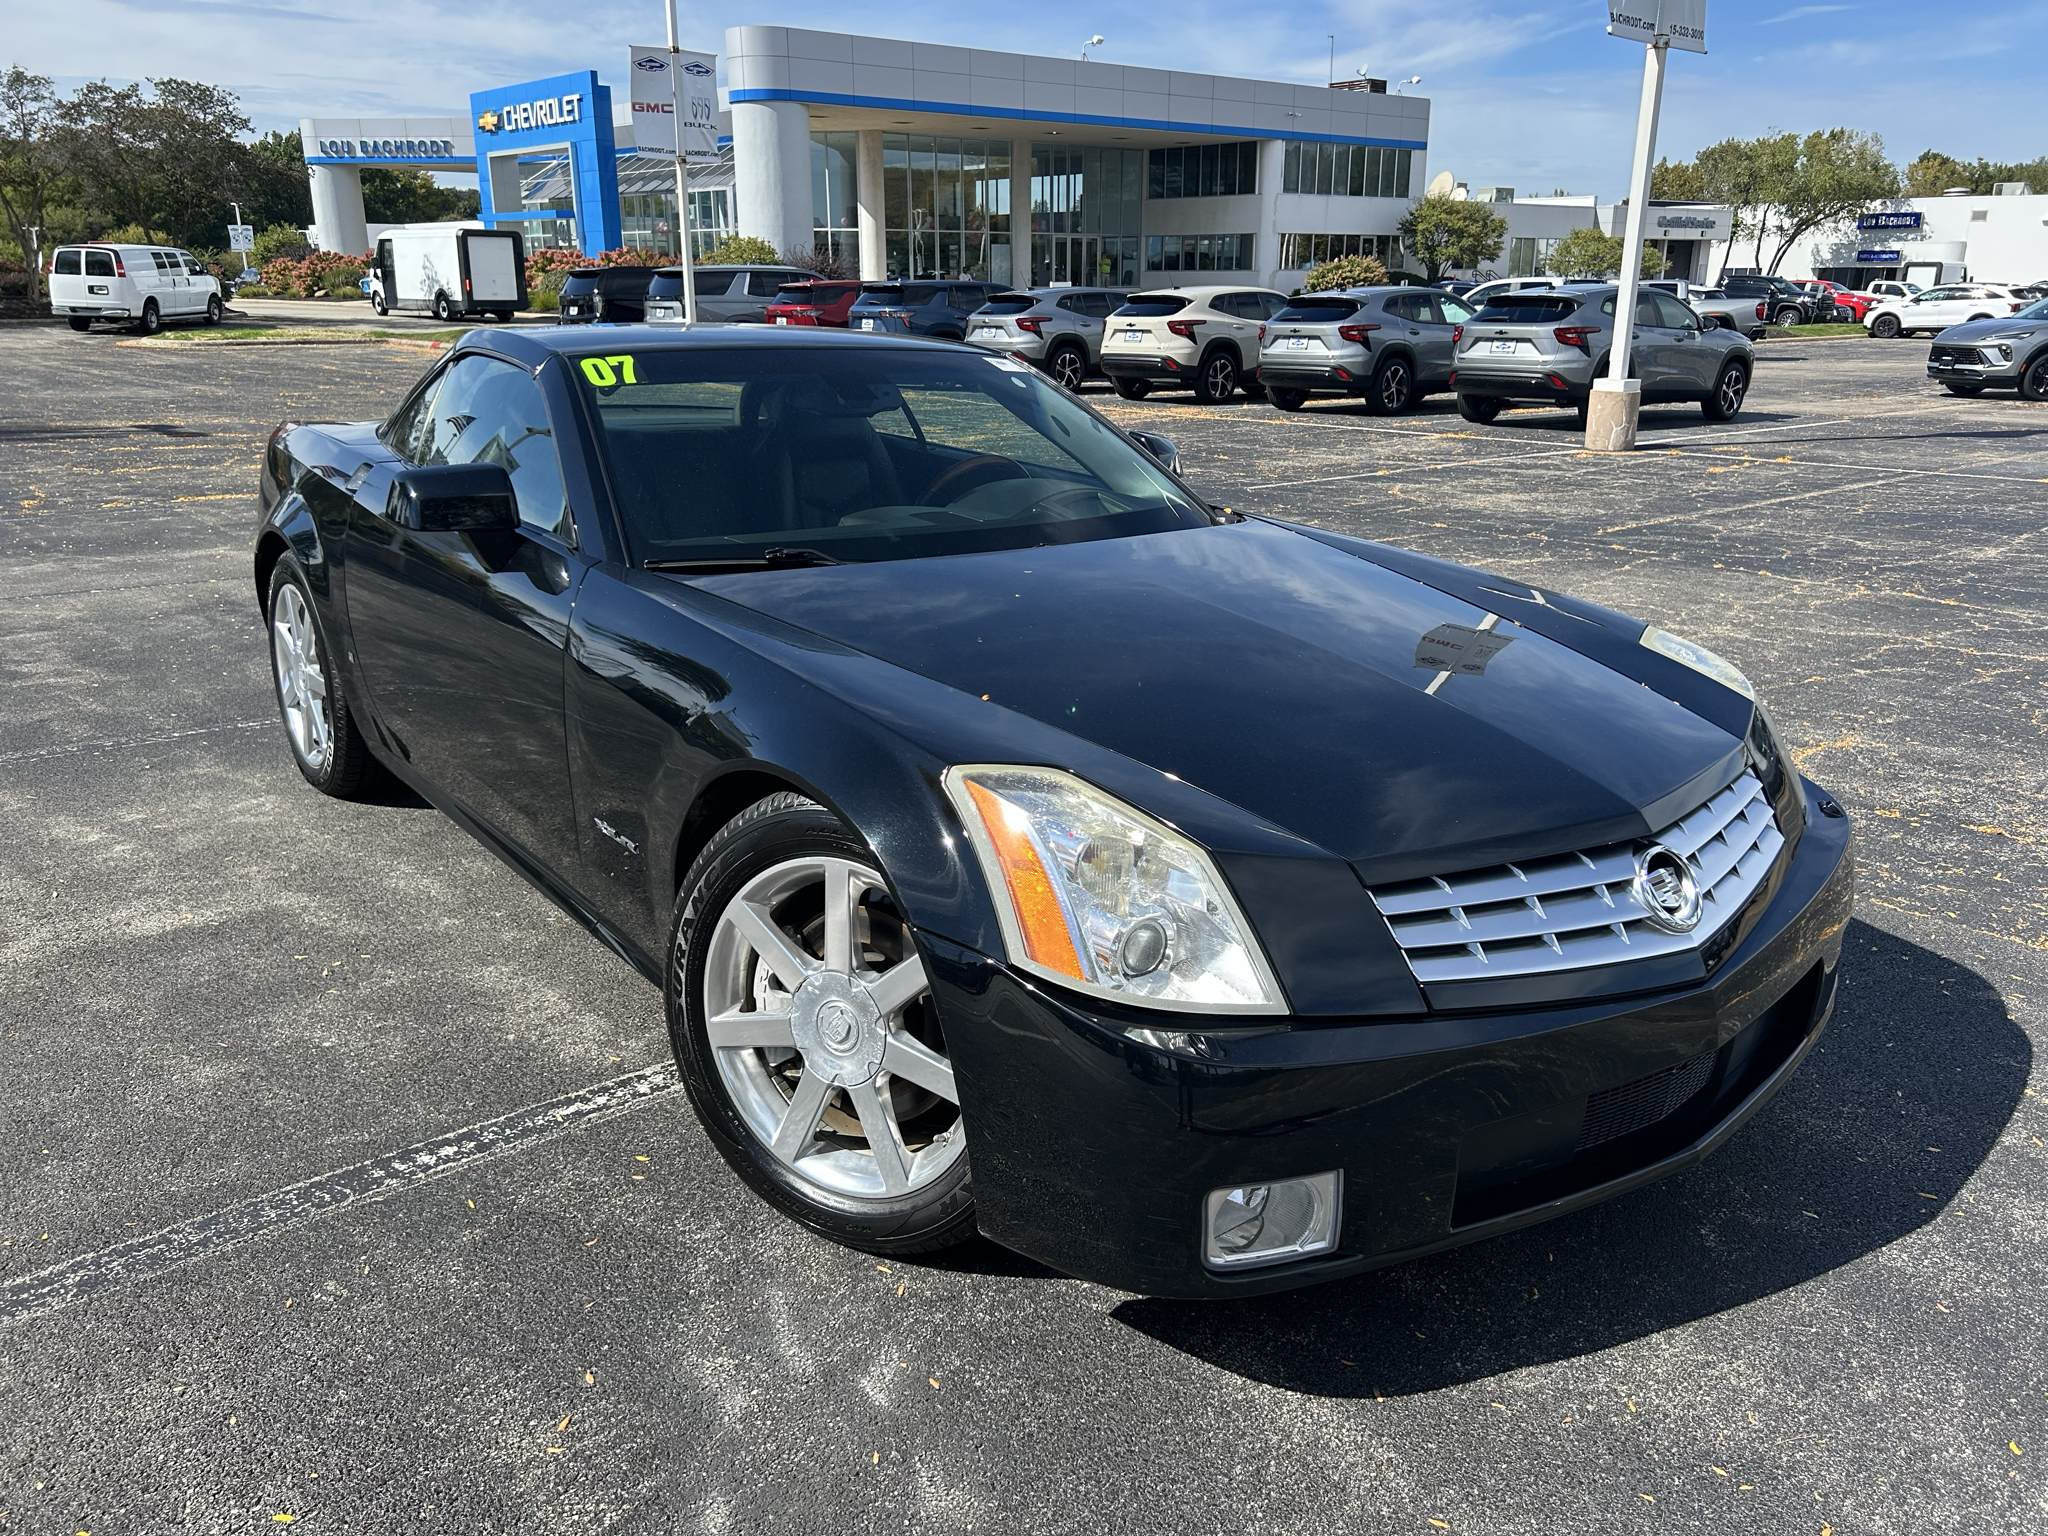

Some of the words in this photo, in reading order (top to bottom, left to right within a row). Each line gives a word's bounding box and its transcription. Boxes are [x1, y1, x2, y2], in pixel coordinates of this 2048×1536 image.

[503, 93, 580, 131] CHEVROLET
[632, 102, 674, 114] GMC
[684, 121, 718, 131] BUICK
[319, 139, 352, 154] LOU
[359, 139, 453, 156] BACHRODT
[580, 355, 637, 386] 07
